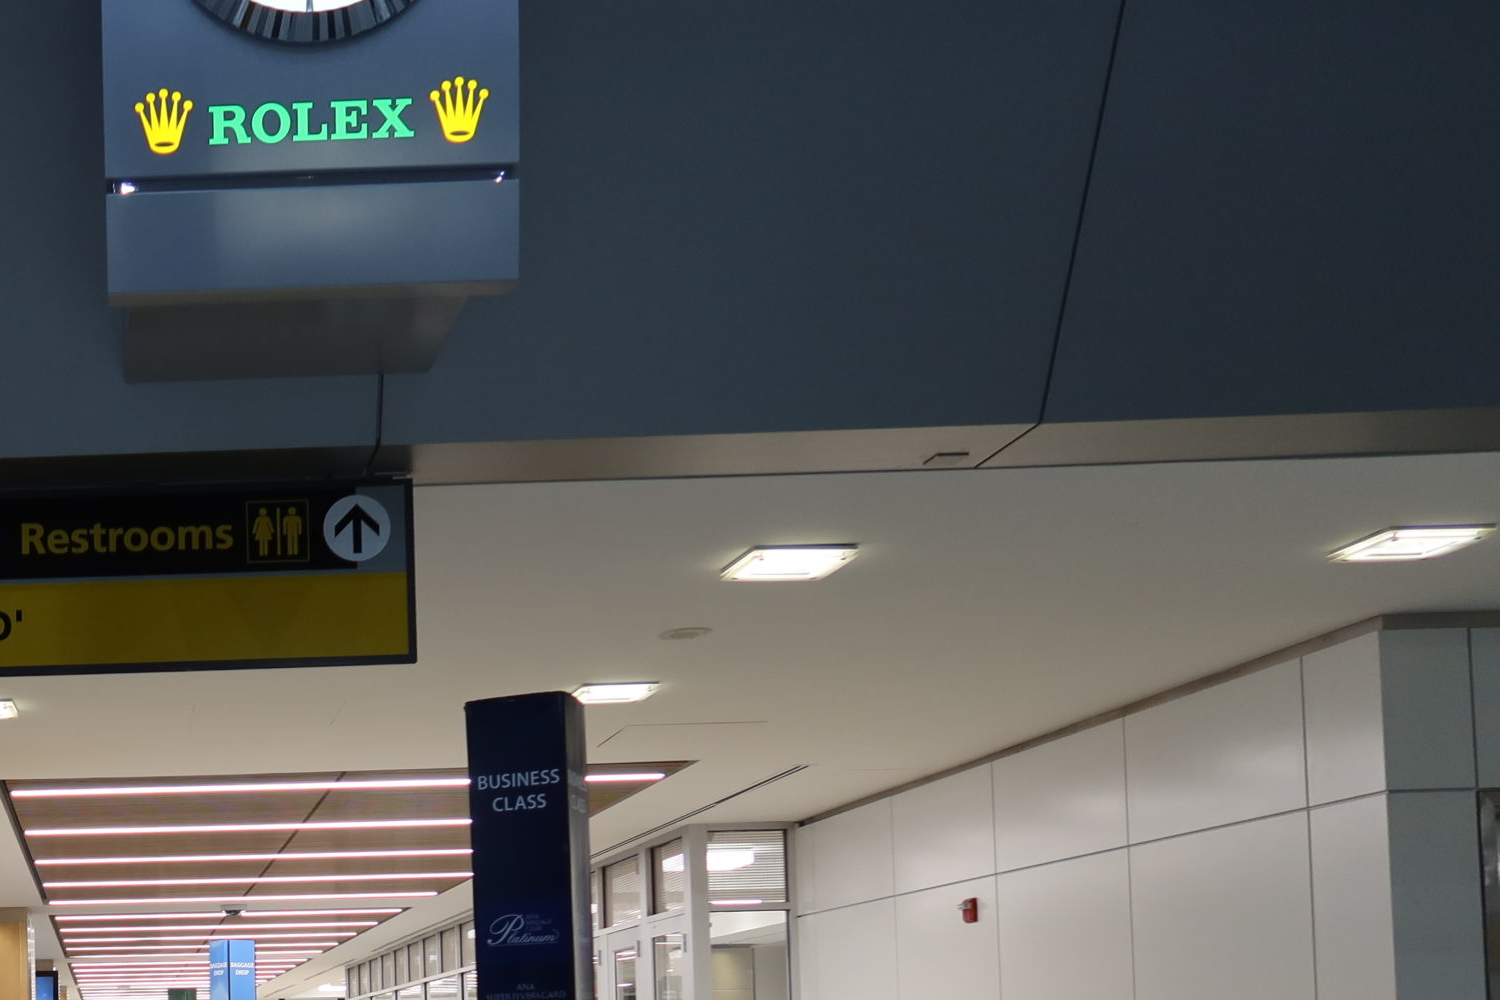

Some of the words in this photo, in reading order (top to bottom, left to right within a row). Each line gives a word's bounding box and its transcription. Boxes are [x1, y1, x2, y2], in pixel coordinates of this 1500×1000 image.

[207, 97, 415, 146] ROLEX
[20, 523, 234, 556] Restrooms
[477, 768, 560, 791] BUSINESS
[492, 793, 547, 812] CLASS
[487, 913, 560, 946] Platinum
